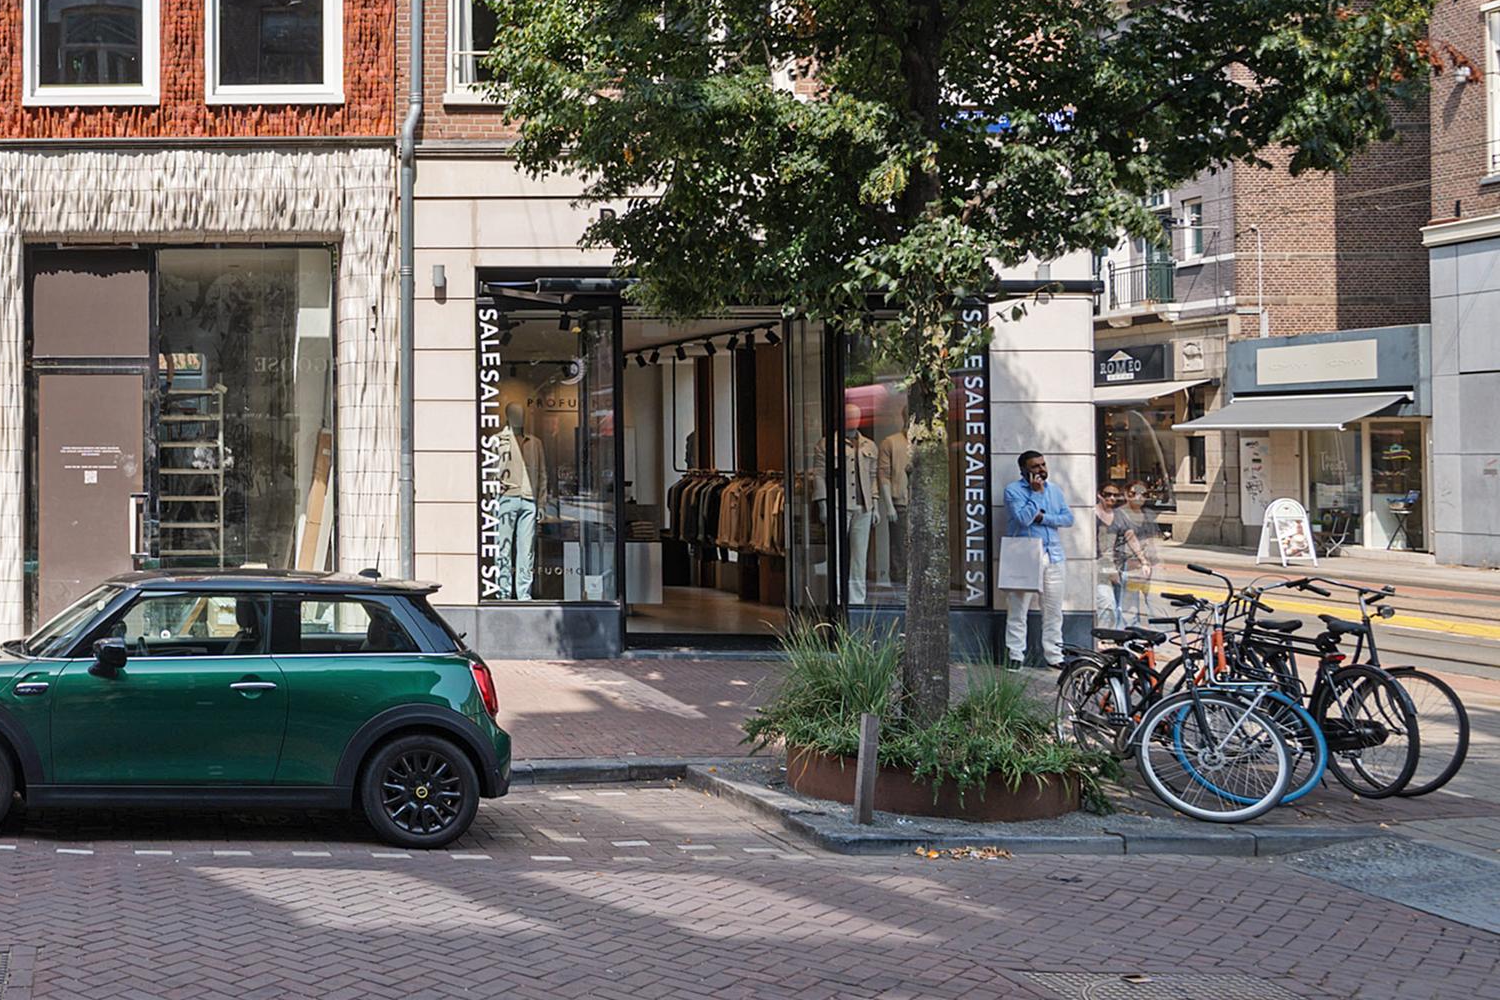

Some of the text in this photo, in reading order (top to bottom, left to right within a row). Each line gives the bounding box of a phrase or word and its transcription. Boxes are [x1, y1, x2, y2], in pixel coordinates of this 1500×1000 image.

[1100, 360, 1141, 374] ROMEO
[965, 376, 984, 435] SALE
[479, 308, 501, 597] SALE SALE SALE SALE SA
[965, 442, 985, 500] SALE
[966, 503, 985, 562] SALE
[966, 570, 985, 601] SA
